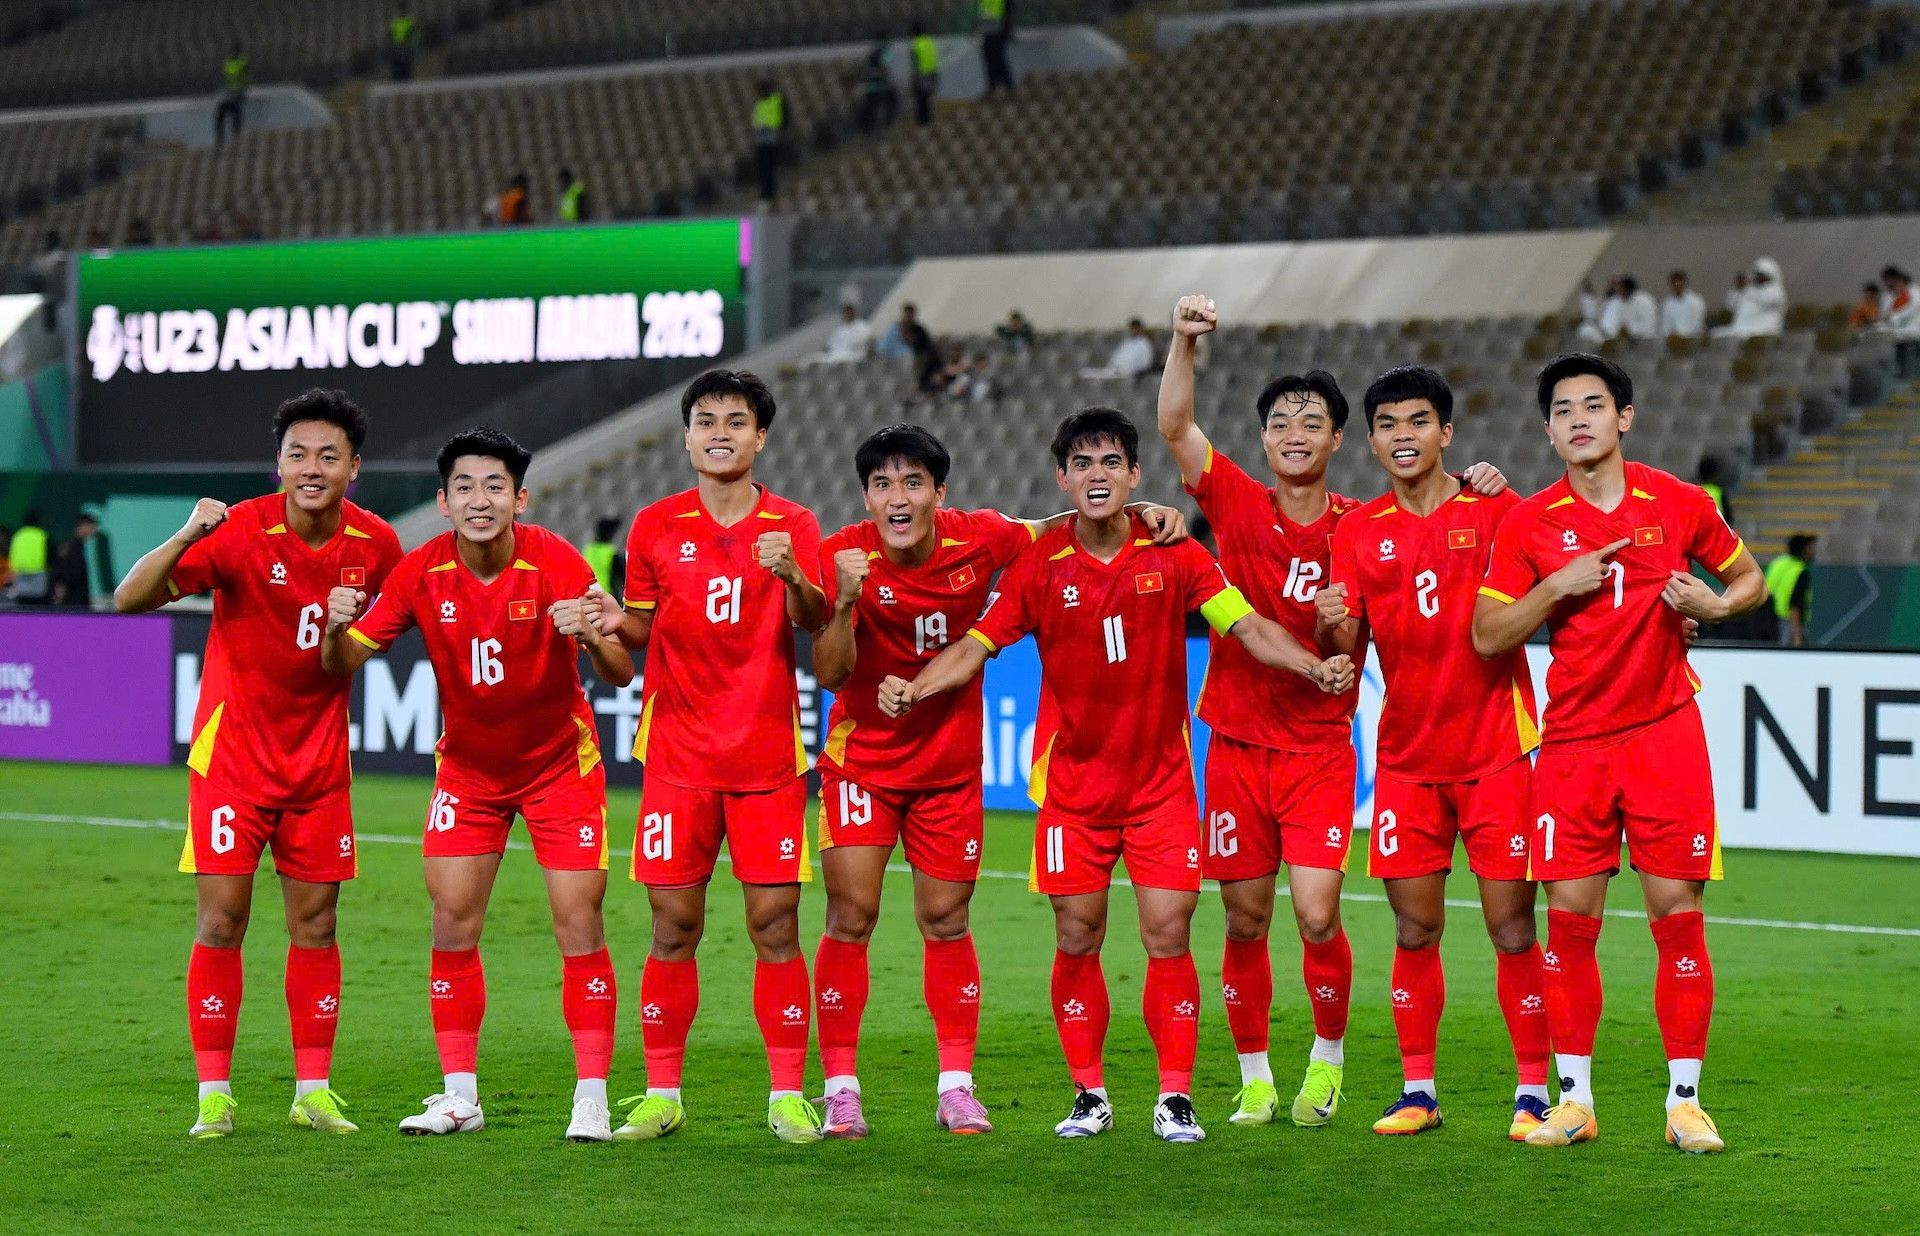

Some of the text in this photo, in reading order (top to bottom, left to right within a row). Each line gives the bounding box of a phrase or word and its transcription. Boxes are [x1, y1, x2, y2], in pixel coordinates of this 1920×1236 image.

[141, 311, 220, 374] U23
[218, 305, 350, 371] ASIAN
[348, 301, 441, 368] CUP
[642, 289, 724, 357] 2026
[706, 575, 743, 625] 21
[1282, 557, 1322, 603] 12
[1415, 569, 1440, 619] 2
[1604, 560, 1625, 609] 7
[296, 602, 324, 650] 6
[914, 611, 947, 656] 19
[1103, 614, 1127, 664] 11
[471, 637, 505, 686] 16
[427, 788, 460, 833] 16
[839, 780, 872, 827] 19
[211, 804, 236, 855] 6
[643, 812, 672, 861] 21
[1046, 825, 1065, 874] 11
[1209, 811, 1238, 858] 12
[1377, 808, 1399, 857] 2
[1537, 812, 1555, 862] 7
